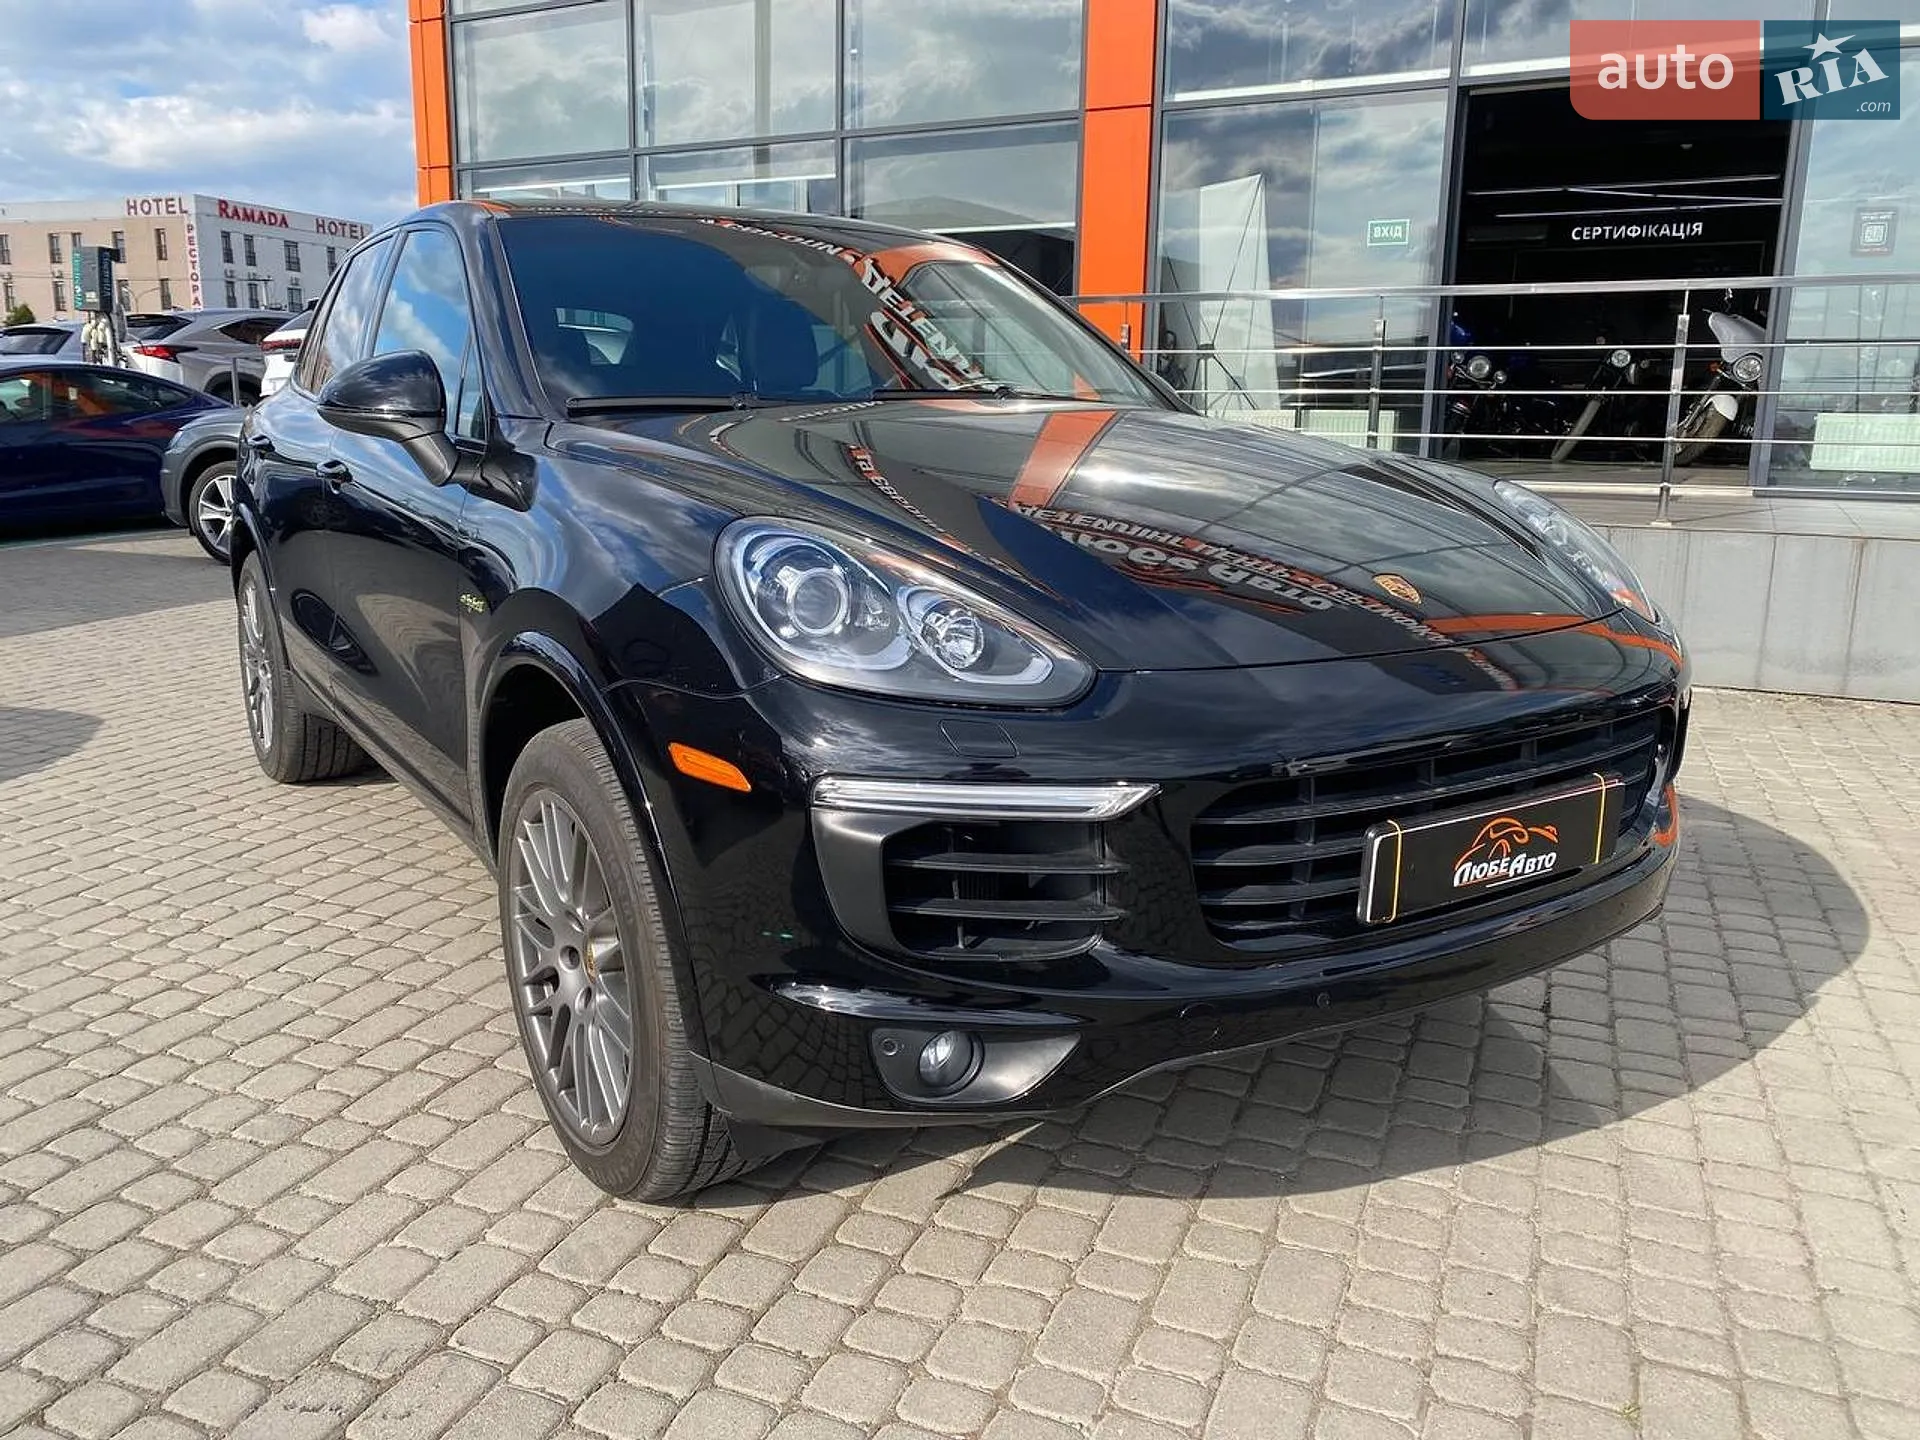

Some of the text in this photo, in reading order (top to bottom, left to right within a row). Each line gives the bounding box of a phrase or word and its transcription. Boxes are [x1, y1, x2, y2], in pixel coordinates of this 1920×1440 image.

[126, 197, 189, 216] HOTEL
[315, 217, 366, 240] HOTEL
[1373, 225, 1403, 239] ВХІД
[1571, 221, 1704, 241] СЕРТИФІКАЦІЯ
